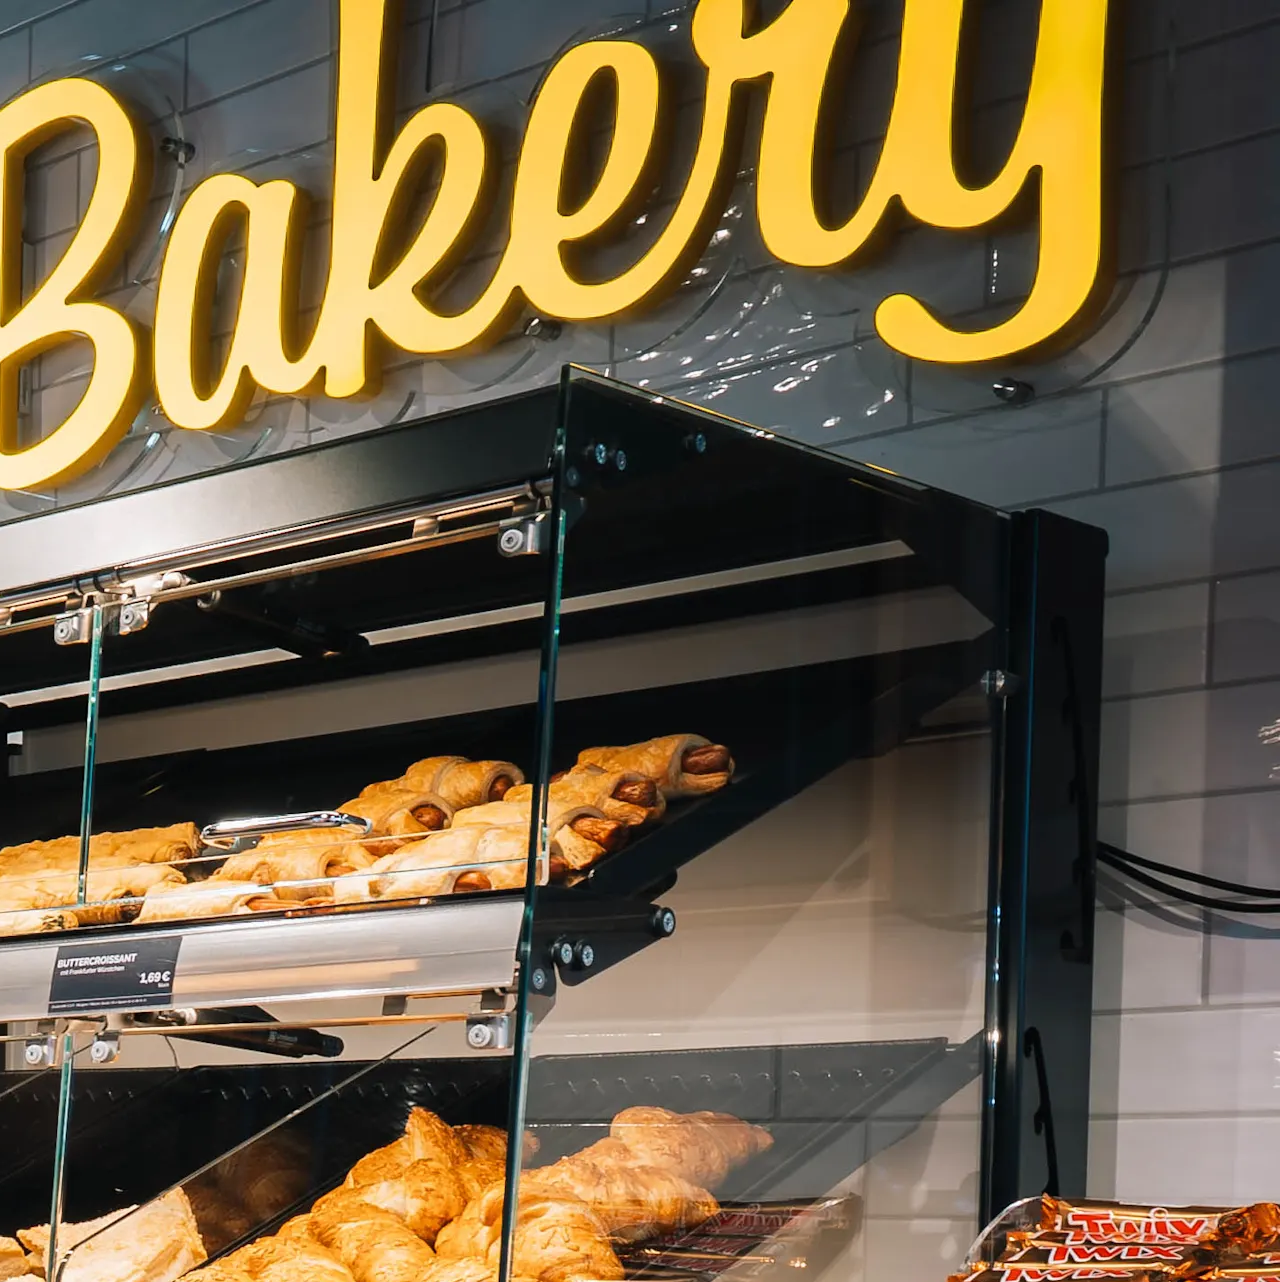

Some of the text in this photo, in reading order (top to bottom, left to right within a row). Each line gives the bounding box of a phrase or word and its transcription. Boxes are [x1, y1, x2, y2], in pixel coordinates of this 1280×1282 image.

[57, 953, 138, 969] BUTTERCROISSANT
[139, 971, 171, 985] 1,69 €
